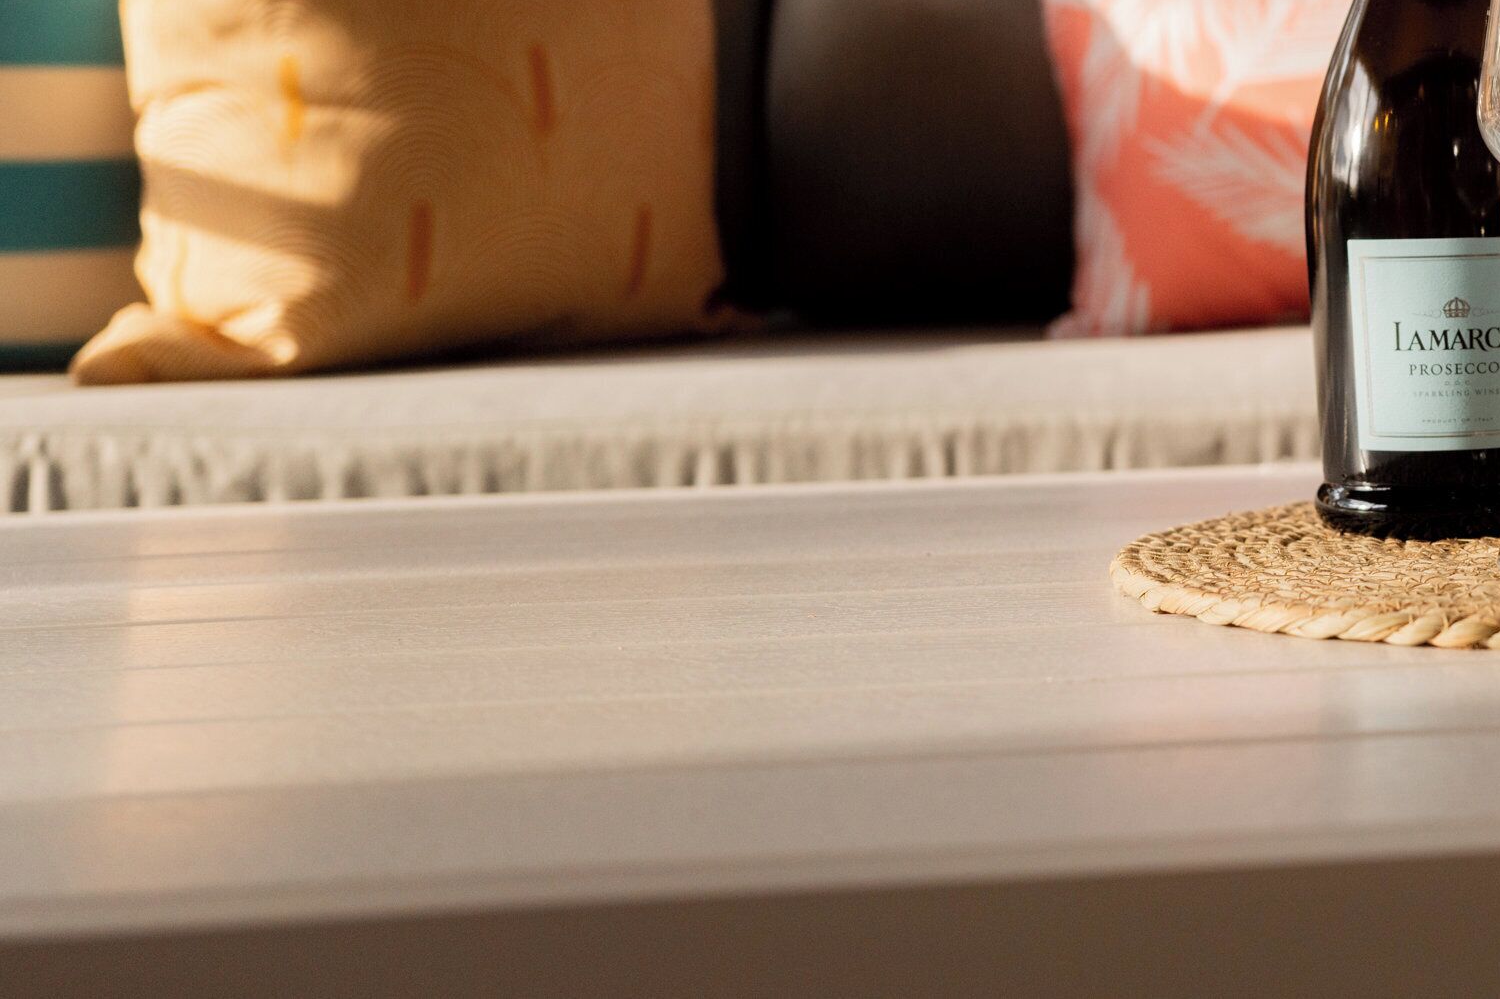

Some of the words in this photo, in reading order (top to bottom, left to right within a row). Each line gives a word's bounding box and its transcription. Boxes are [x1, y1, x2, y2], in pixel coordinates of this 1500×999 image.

[1408, 361, 1500, 376] PROSECCO
[1413, 389, 1470, 398] SPARKLING
[1475, 388, 1500, 396] WINE
